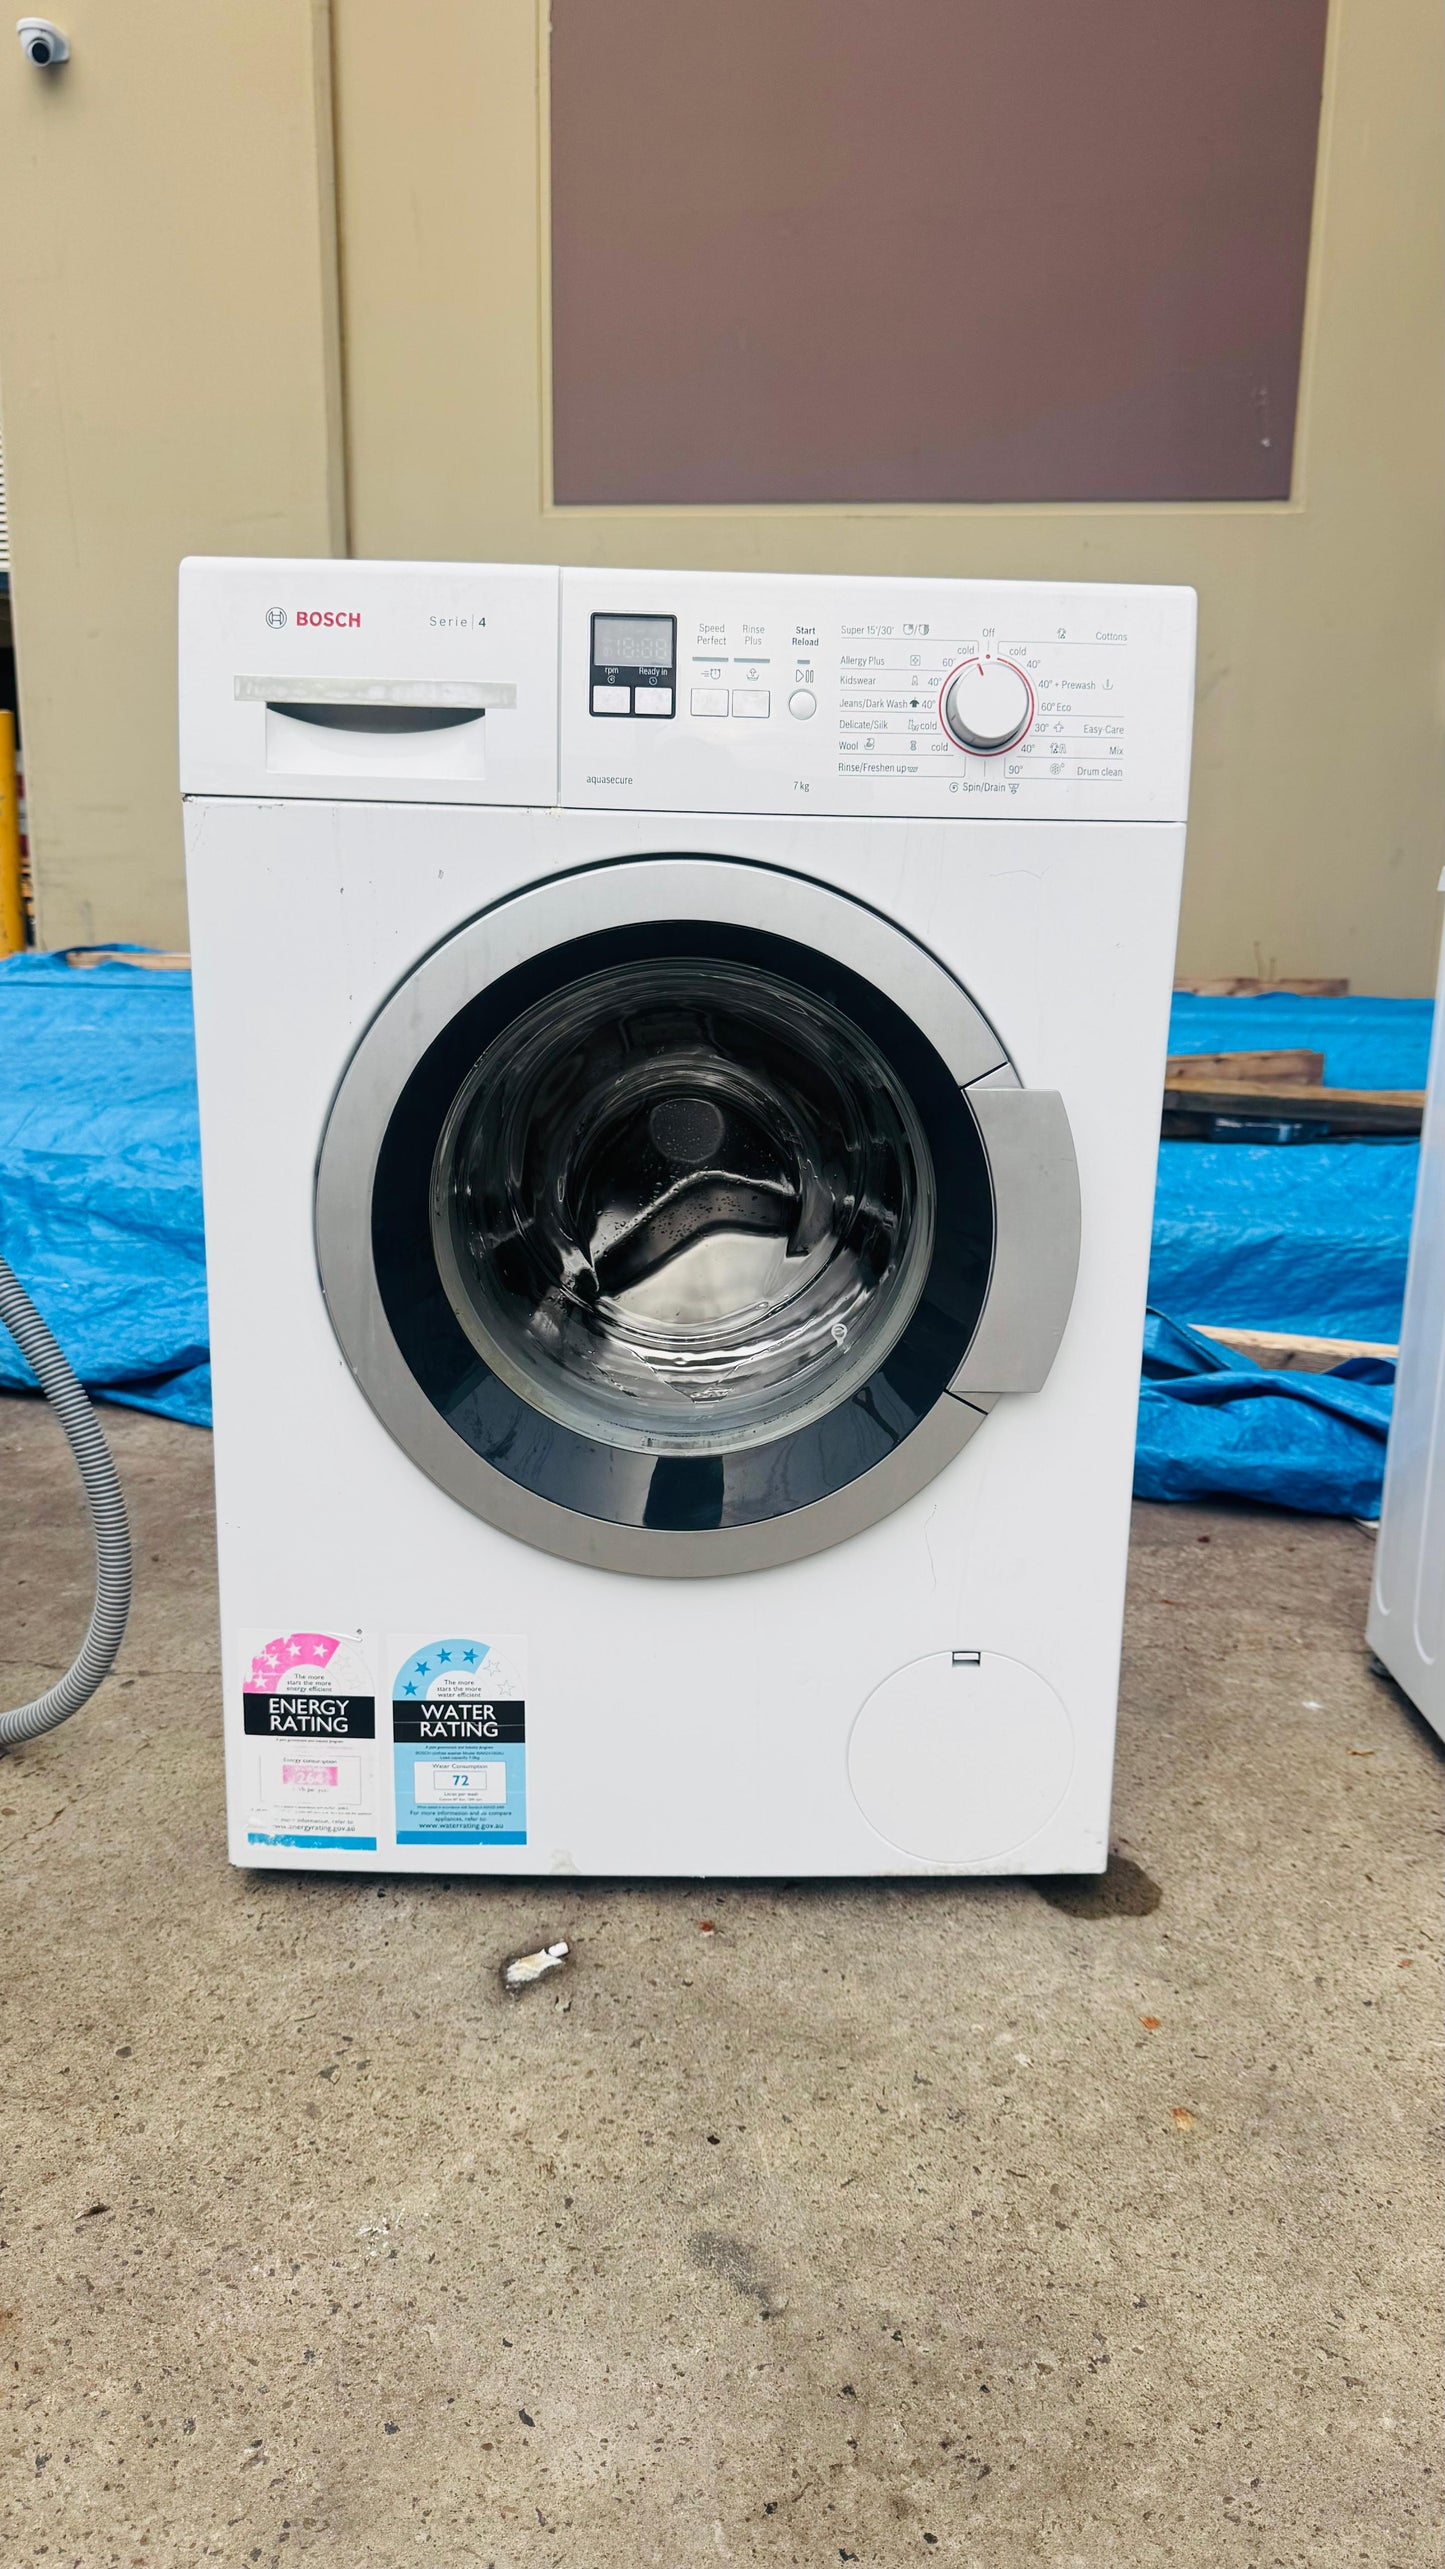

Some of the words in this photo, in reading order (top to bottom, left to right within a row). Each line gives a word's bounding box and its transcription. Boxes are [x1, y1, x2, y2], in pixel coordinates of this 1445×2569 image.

[296, 612, 361, 628] BOSCH
[429, 615, 468, 627] Serie
[478, 617, 487, 628] 4
[699, 624, 725, 634] Speed
[742, 624, 765, 634] Rinse
[796, 626, 816, 636] Start
[841, 626, 864, 635] Super
[982, 628, 995, 638] Off
[697, 636, 727, 646] Perfect
[744, 636, 762, 646] Plus
[1096, 632, 1128, 641] Cottons
[792, 637, 819, 647] Reload
[957, 645, 974, 655] cold
[1009, 647, 1026, 656] cold
[840, 656, 867, 667] Allergy
[868, 656, 885, 665] Plus
[639, 667, 659, 676] Ready
[840, 676, 876, 685] Kidswear
[1061, 681, 1096, 690] Prewash
[840, 698, 885, 708] Jeans/Dark
[886, 700, 908, 708] Wash
[1057, 704, 1071, 712] Eco
[839, 720, 888, 730] Delicate/Silk
[920, 722, 937, 730] cold
[839, 741, 858, 750] Wool
[931, 743, 948, 752] cold
[1109, 746, 1124, 755] Mix
[838, 763, 895, 773] Rinse/Freshen
[896, 765, 907, 773] up
[1077, 767, 1100, 776] Drum
[1101, 768, 1123, 776] clean
[586, 775, 633, 785] aquasecure
[793, 782, 798, 790] 7
[800, 782, 810, 792] kg
[962, 782, 1006, 793] Spin/Drain
[269, 1698, 350, 1716] ENERGY
[421, 1704, 496, 1720] WATER
[270, 1716, 349, 1734] RATING
[420, 1722, 499, 1737] RATING
[452, 1775, 469, 1786] 72
